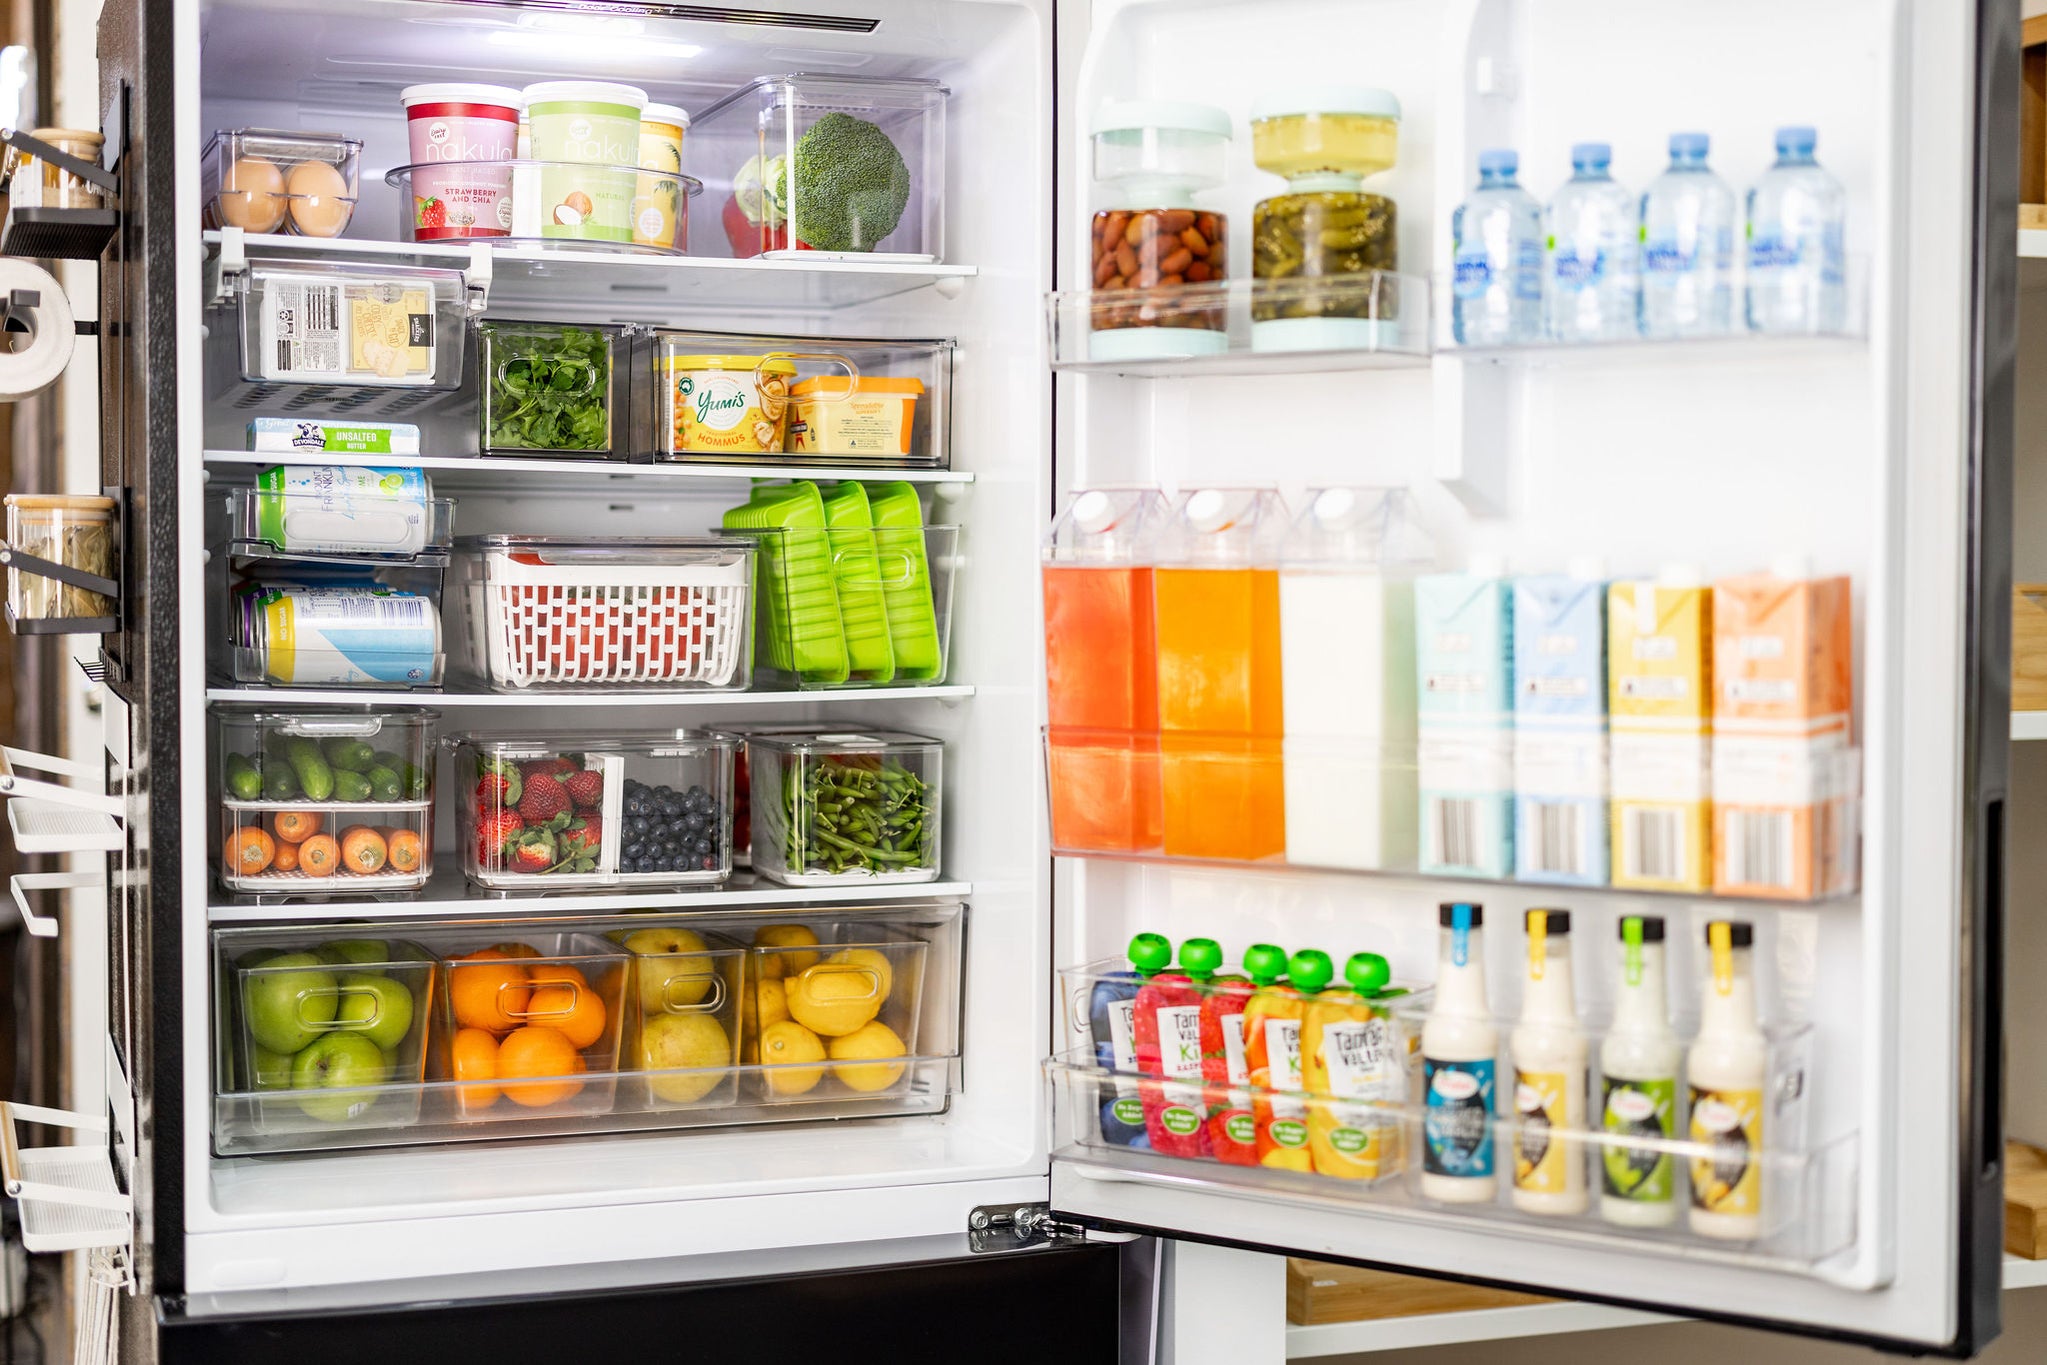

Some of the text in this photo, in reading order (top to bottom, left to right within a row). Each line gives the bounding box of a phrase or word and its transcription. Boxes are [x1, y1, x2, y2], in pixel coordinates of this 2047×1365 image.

[425, 136, 513, 161] nakula
[445, 188, 497, 197] STRAWBERRY
[595, 191, 625, 201] NATURAL
[696, 389, 746, 424] Yumi's
[336, 431, 377, 442] UNSALTED
[697, 432, 746, 447] HOMMUS
[294, 438, 325, 447] DEVONDALE
[346, 442, 367, 450] BUTTER
[279, 606, 287, 641] NO SUGAR
